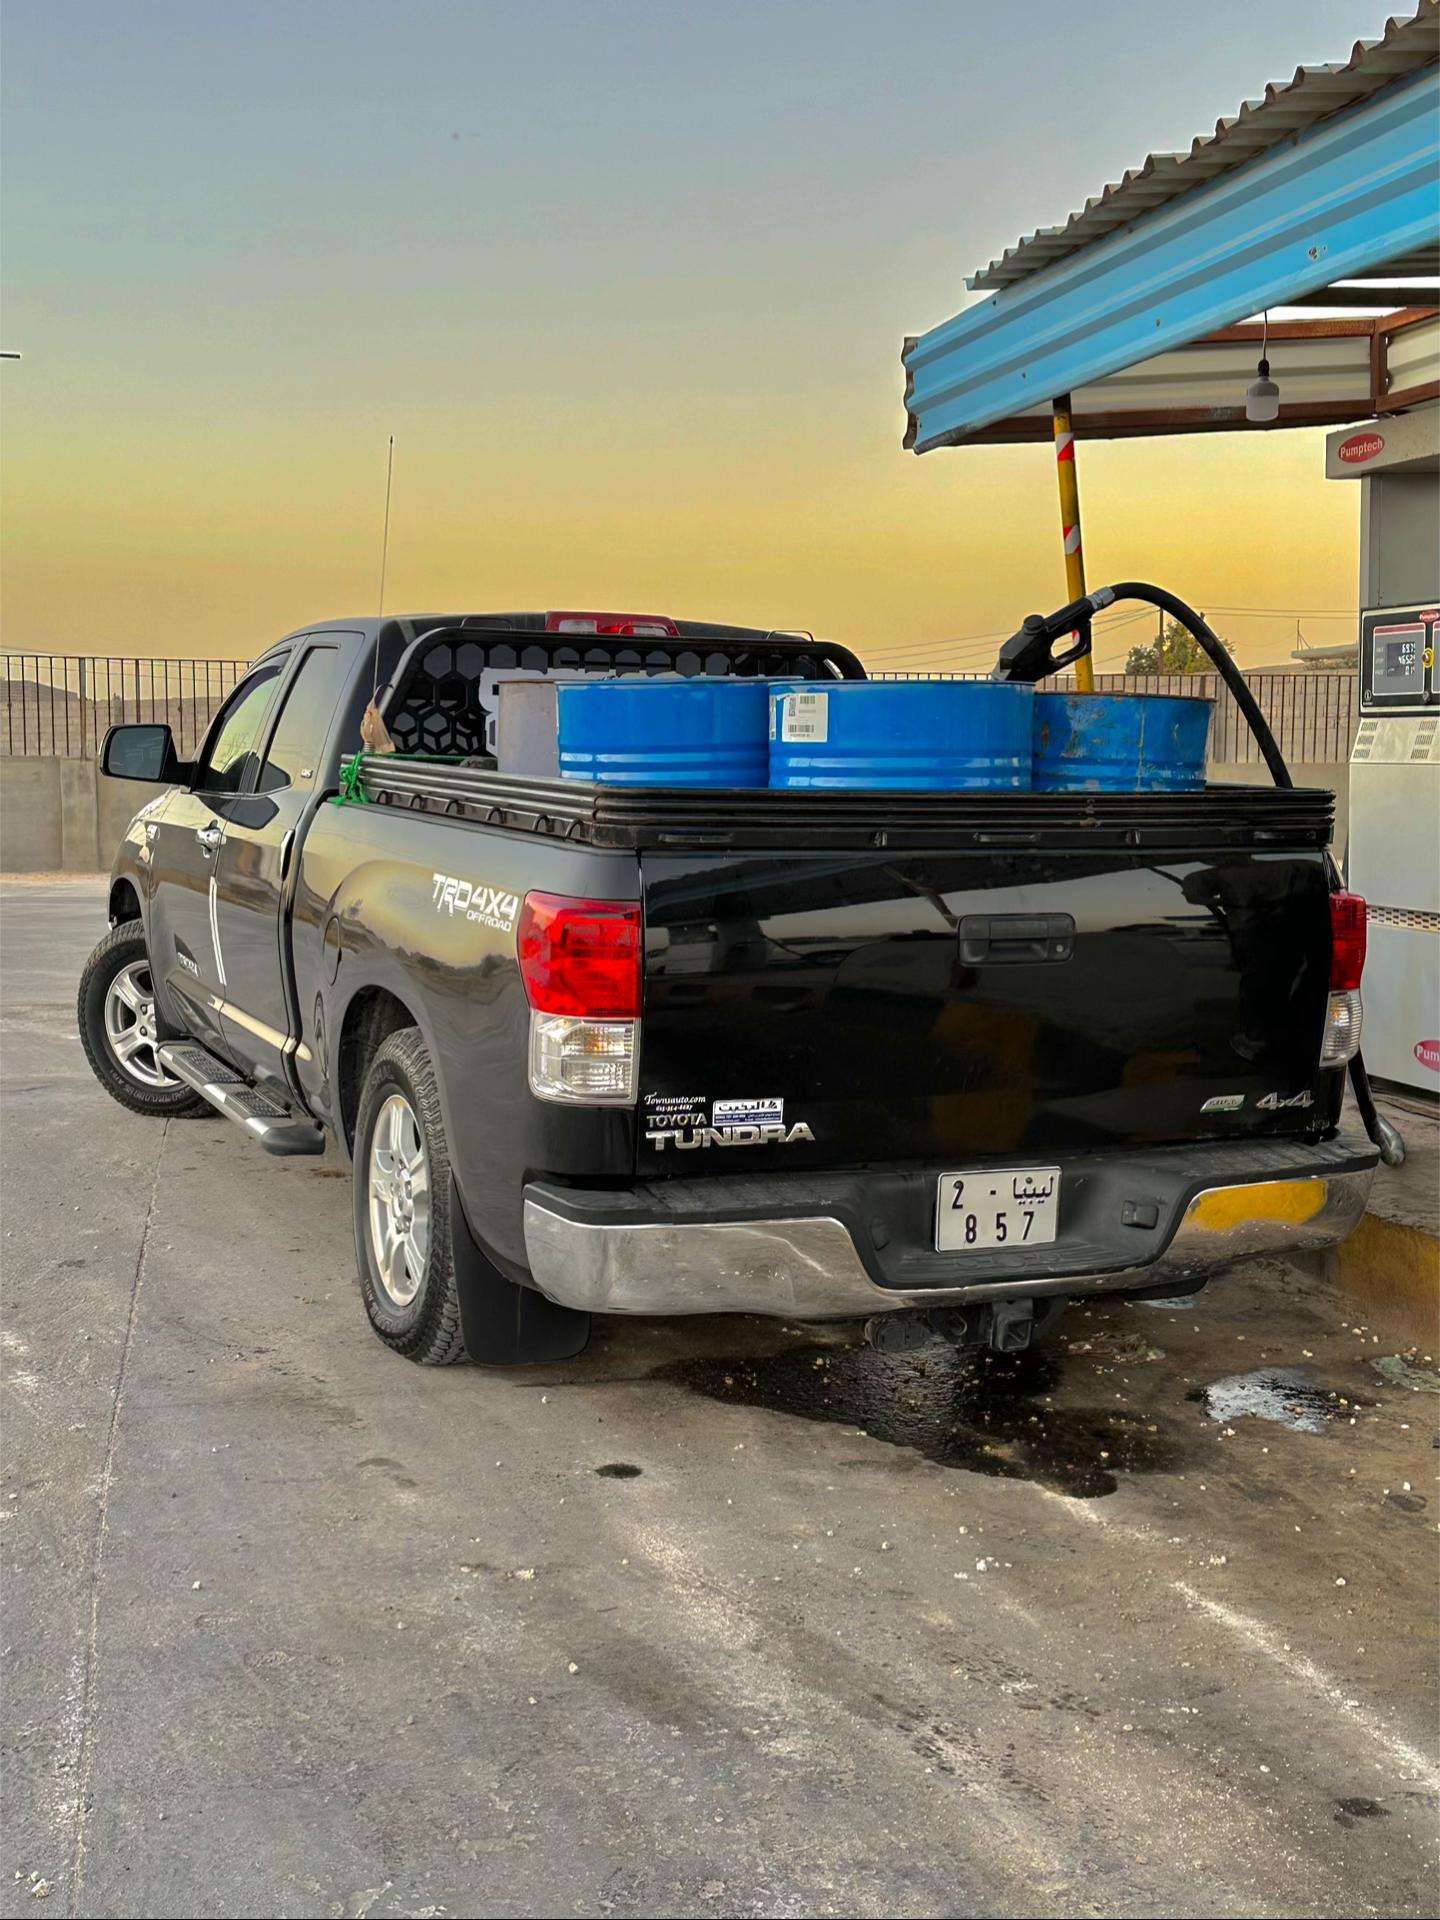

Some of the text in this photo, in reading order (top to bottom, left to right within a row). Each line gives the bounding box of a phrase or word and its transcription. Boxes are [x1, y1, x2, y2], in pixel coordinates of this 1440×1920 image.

[1340, 438, 1383, 458] Pumptech
[646, 1112, 707, 1128] TOYOTA
[645, 1122, 816, 1151] TUNDRA
[951, 1180, 965, 1210] 2
[1012, 1175, 1055, 1206] ليبيا
